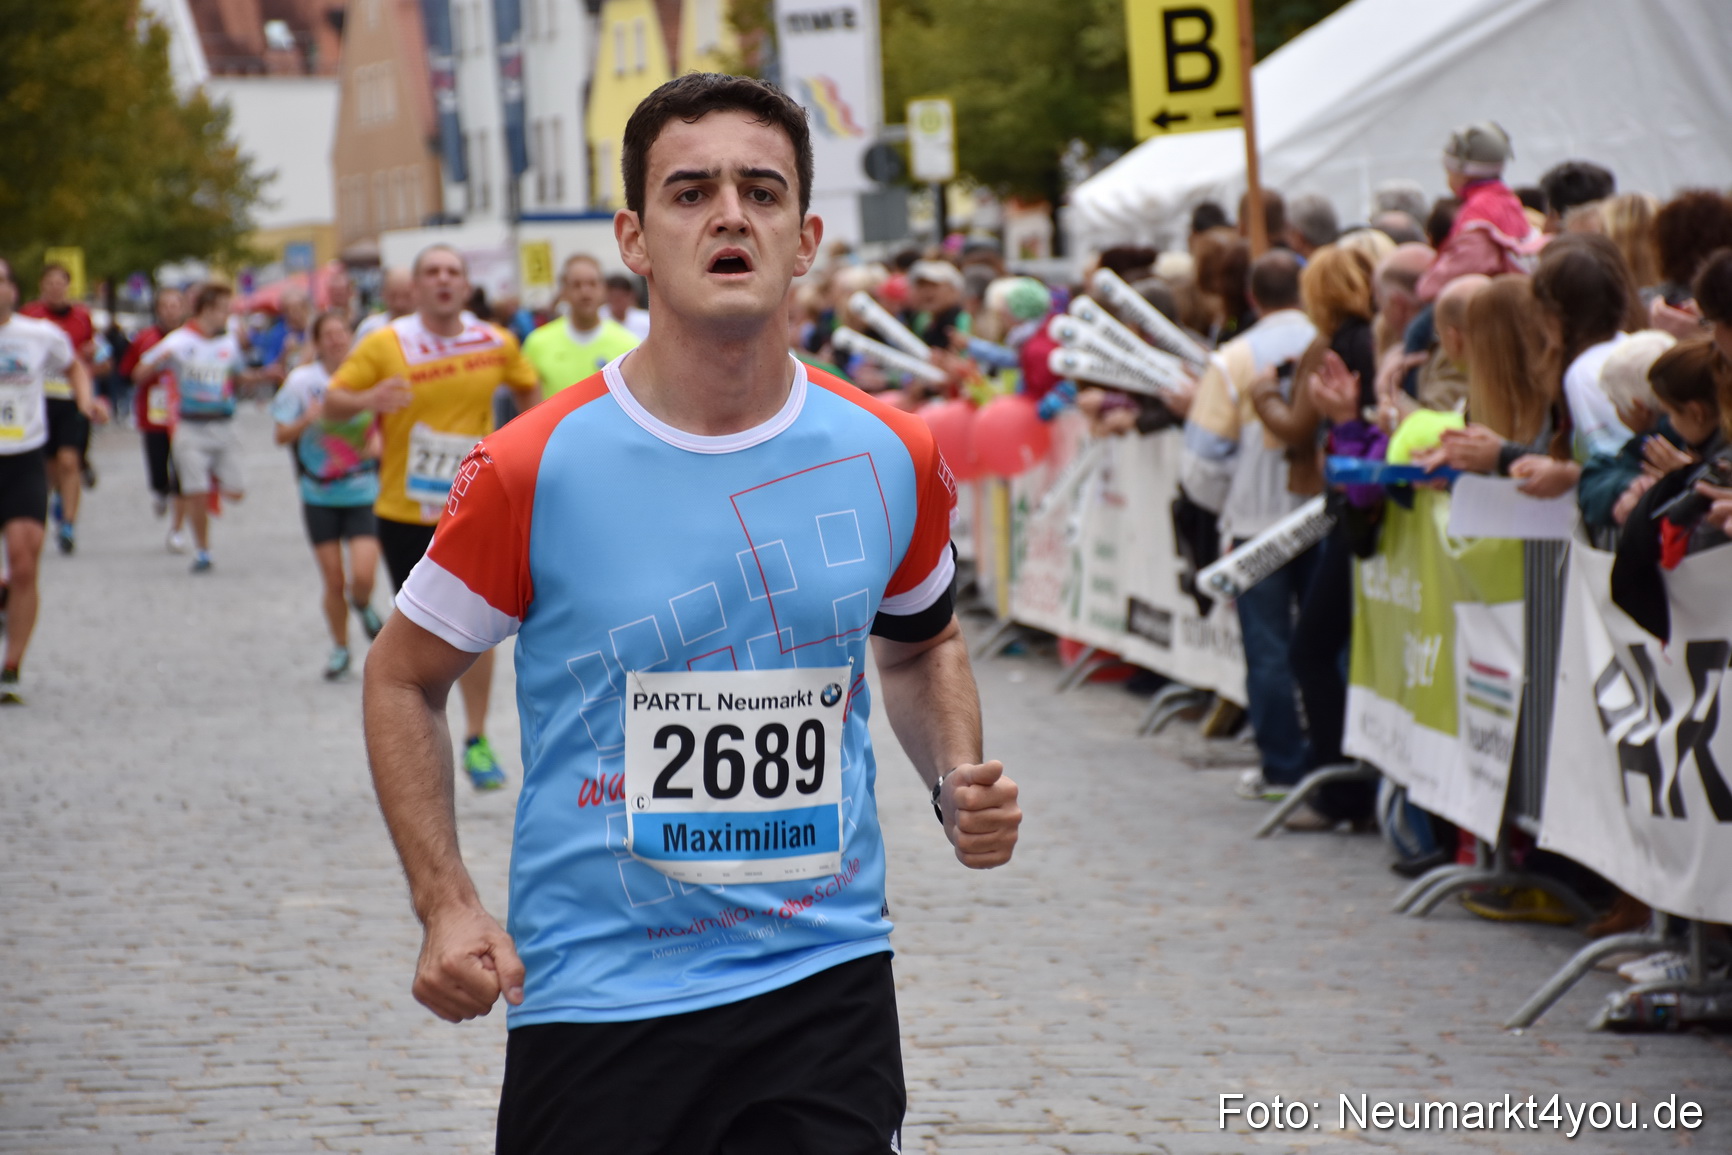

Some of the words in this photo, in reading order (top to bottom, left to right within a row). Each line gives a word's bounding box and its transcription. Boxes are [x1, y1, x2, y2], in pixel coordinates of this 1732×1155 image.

[1162, 8, 1222, 93] B
[633, 693, 711, 712] PARTL
[717, 690, 813, 711] Neumarkt
[652, 718, 826, 799] 2689
[662, 821, 816, 853] Maximilian
